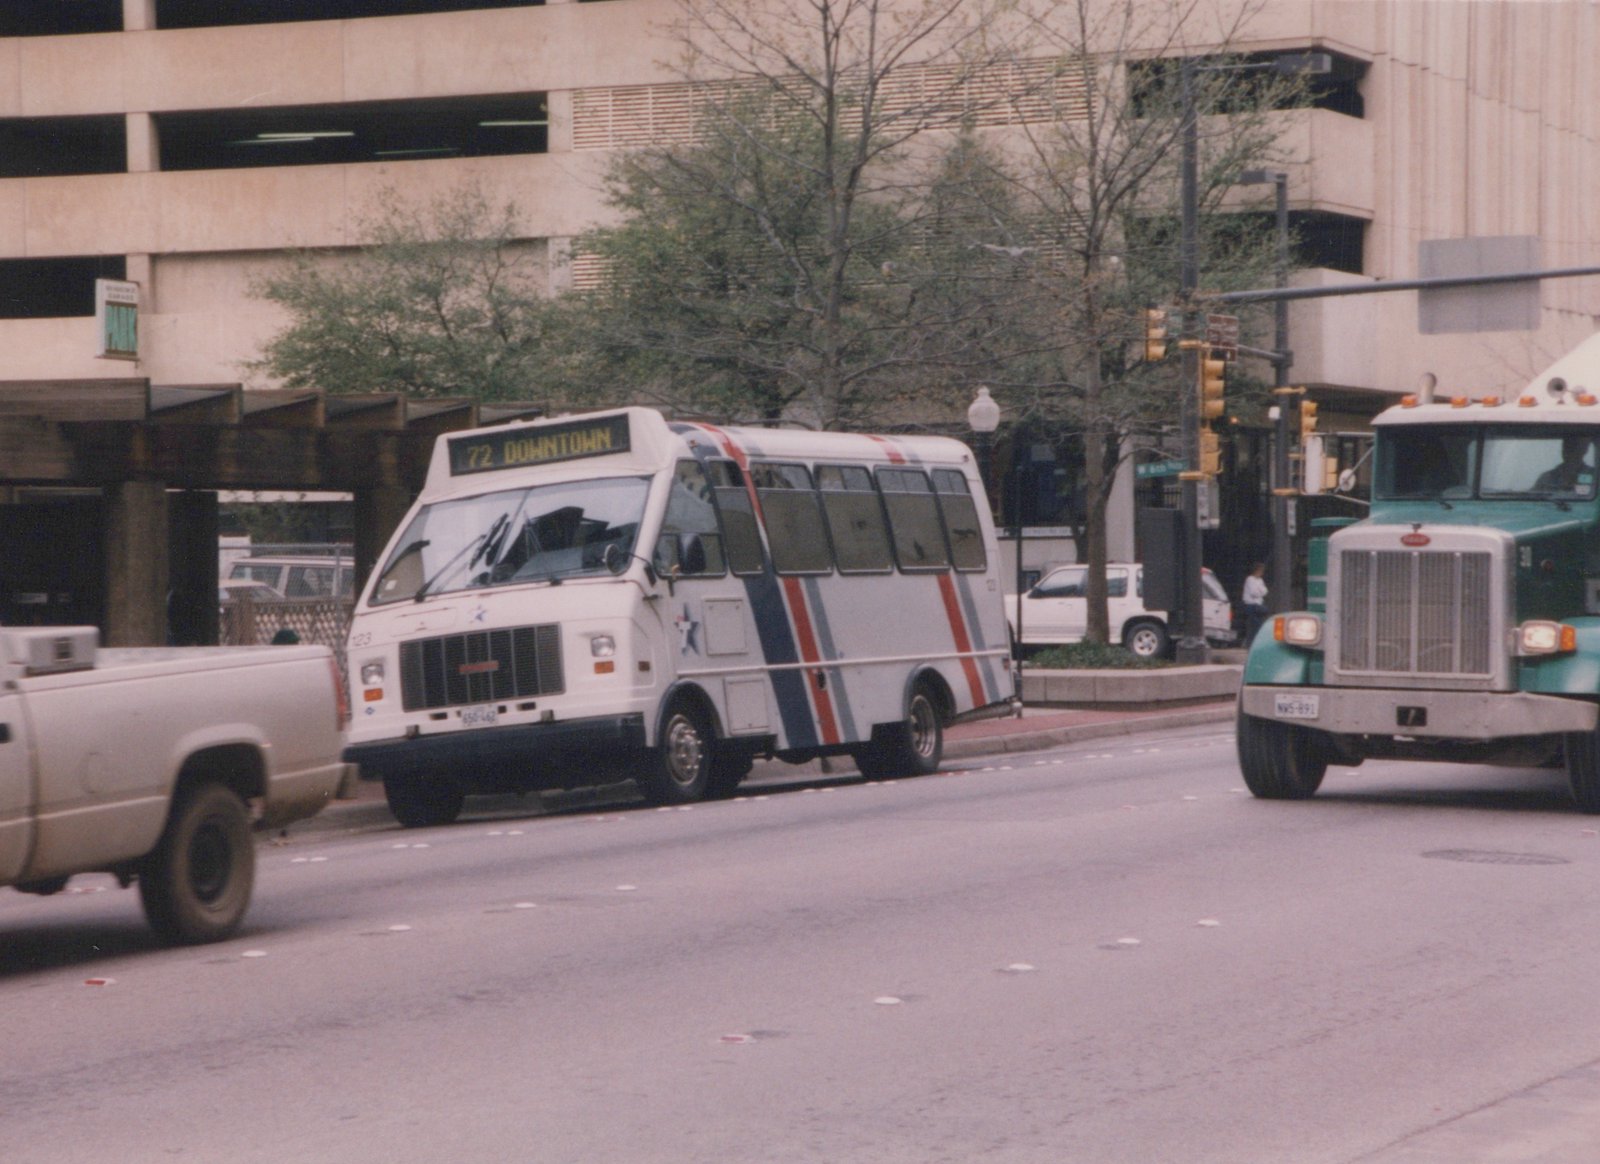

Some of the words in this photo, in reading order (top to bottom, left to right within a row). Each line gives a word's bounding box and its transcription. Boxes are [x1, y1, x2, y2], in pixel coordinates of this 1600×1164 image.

[468, 444, 493, 468] 72
[504, 427, 612, 464] DOWNTOWN
[352, 631, 372, 647] 123
